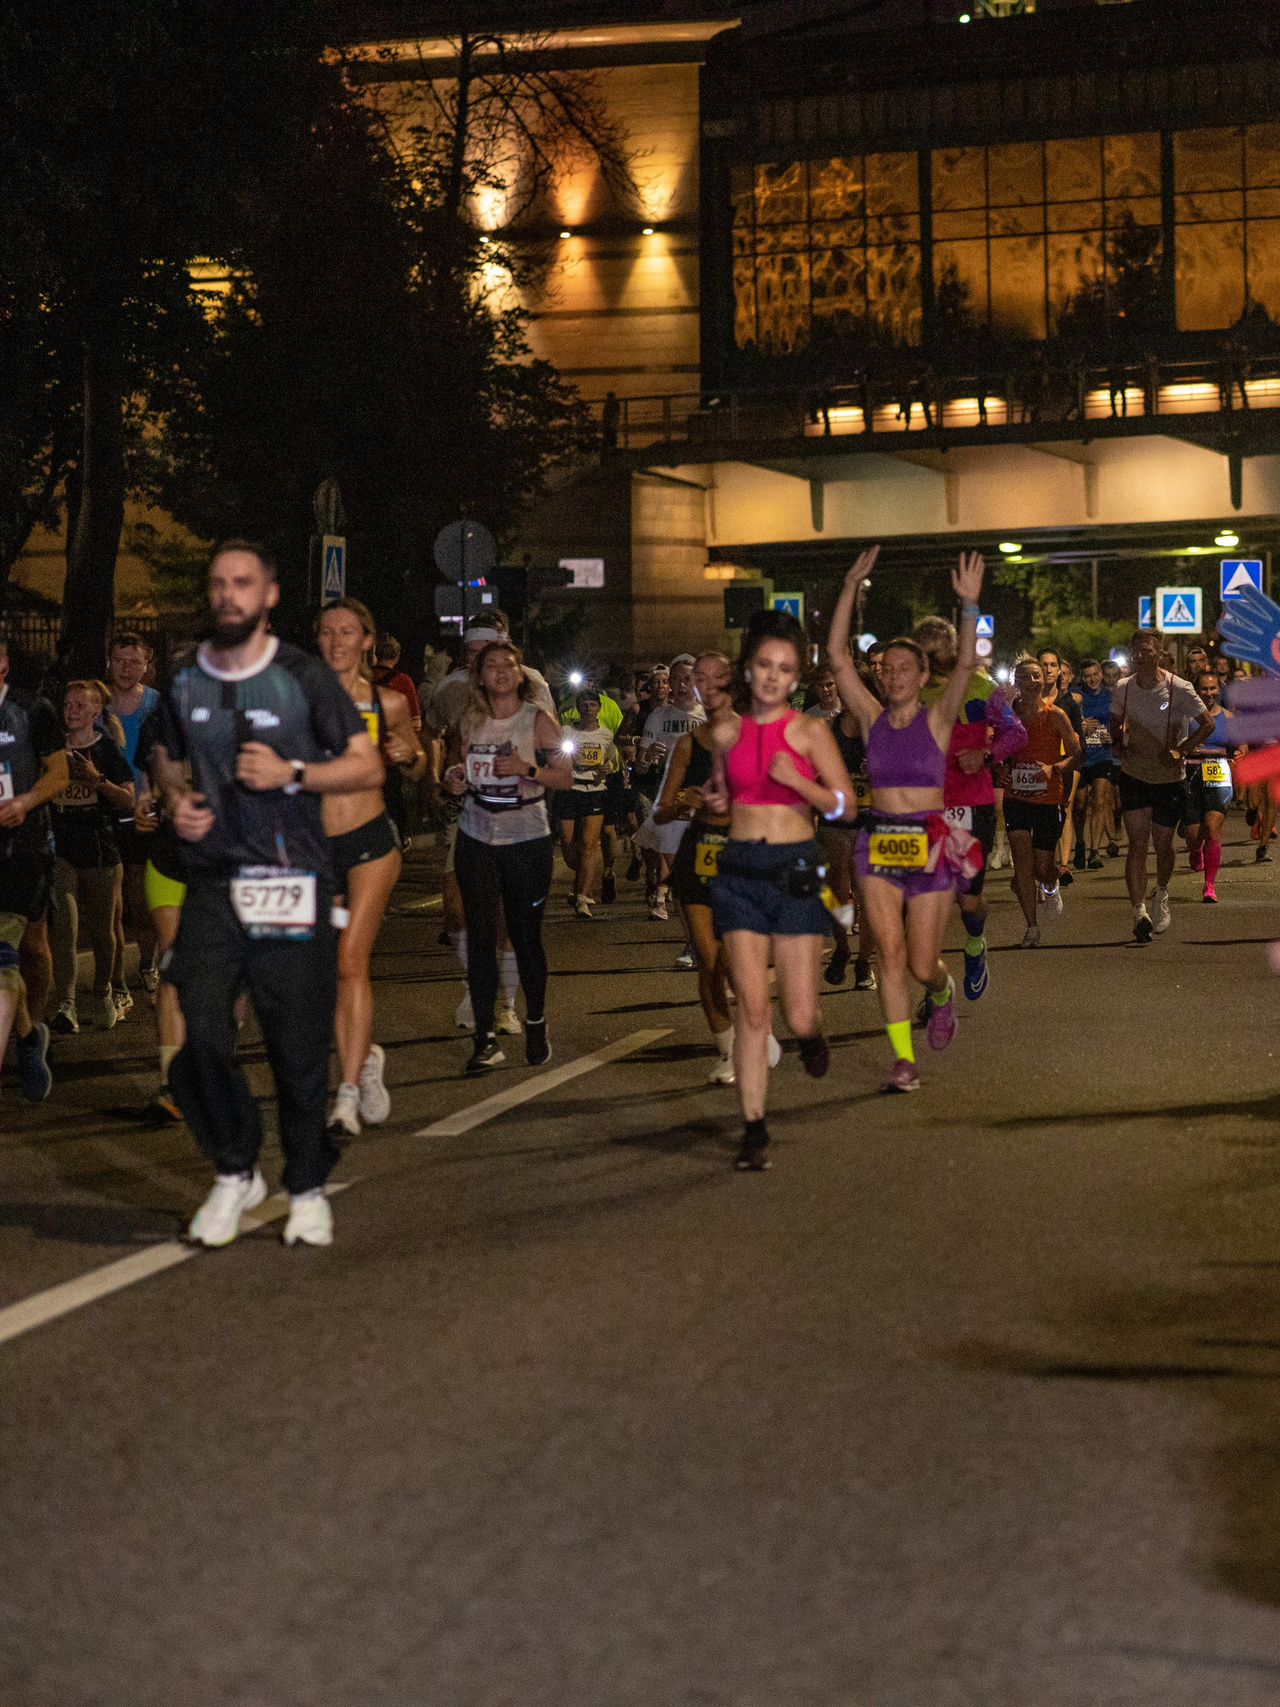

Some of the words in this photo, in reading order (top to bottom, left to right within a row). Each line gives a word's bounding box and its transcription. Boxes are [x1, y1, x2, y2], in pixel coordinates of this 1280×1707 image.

[472, 761, 494, 778] 97
[58, 785, 91, 799] 820
[946, 807, 966, 822] 39
[877, 838, 920, 856] 6005
[241, 884, 303, 909] 5779
